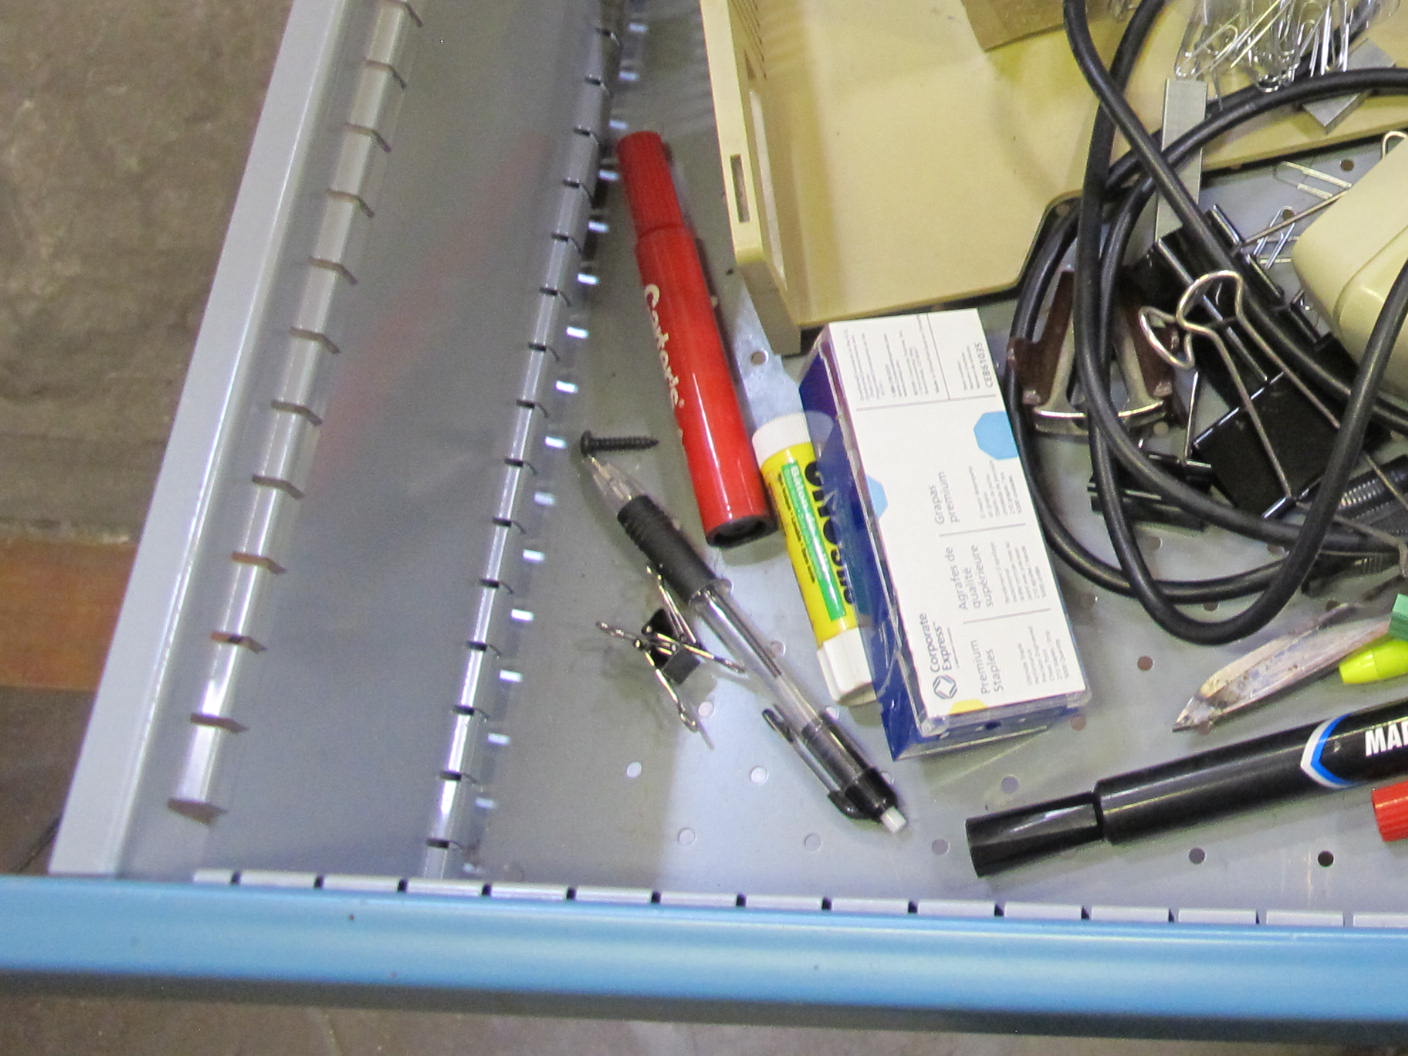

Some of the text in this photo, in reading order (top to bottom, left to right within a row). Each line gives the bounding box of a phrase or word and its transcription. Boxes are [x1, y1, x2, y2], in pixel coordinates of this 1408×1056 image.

[928, 483, 946, 526] Grapas
[937, 470, 961, 524] premium
[944, 545, 969, 611] Agrafes de
[919, 612, 941, 673] Corporate
[970, 639, 992, 696] Premium
[985, 648, 1005, 694] Staples
